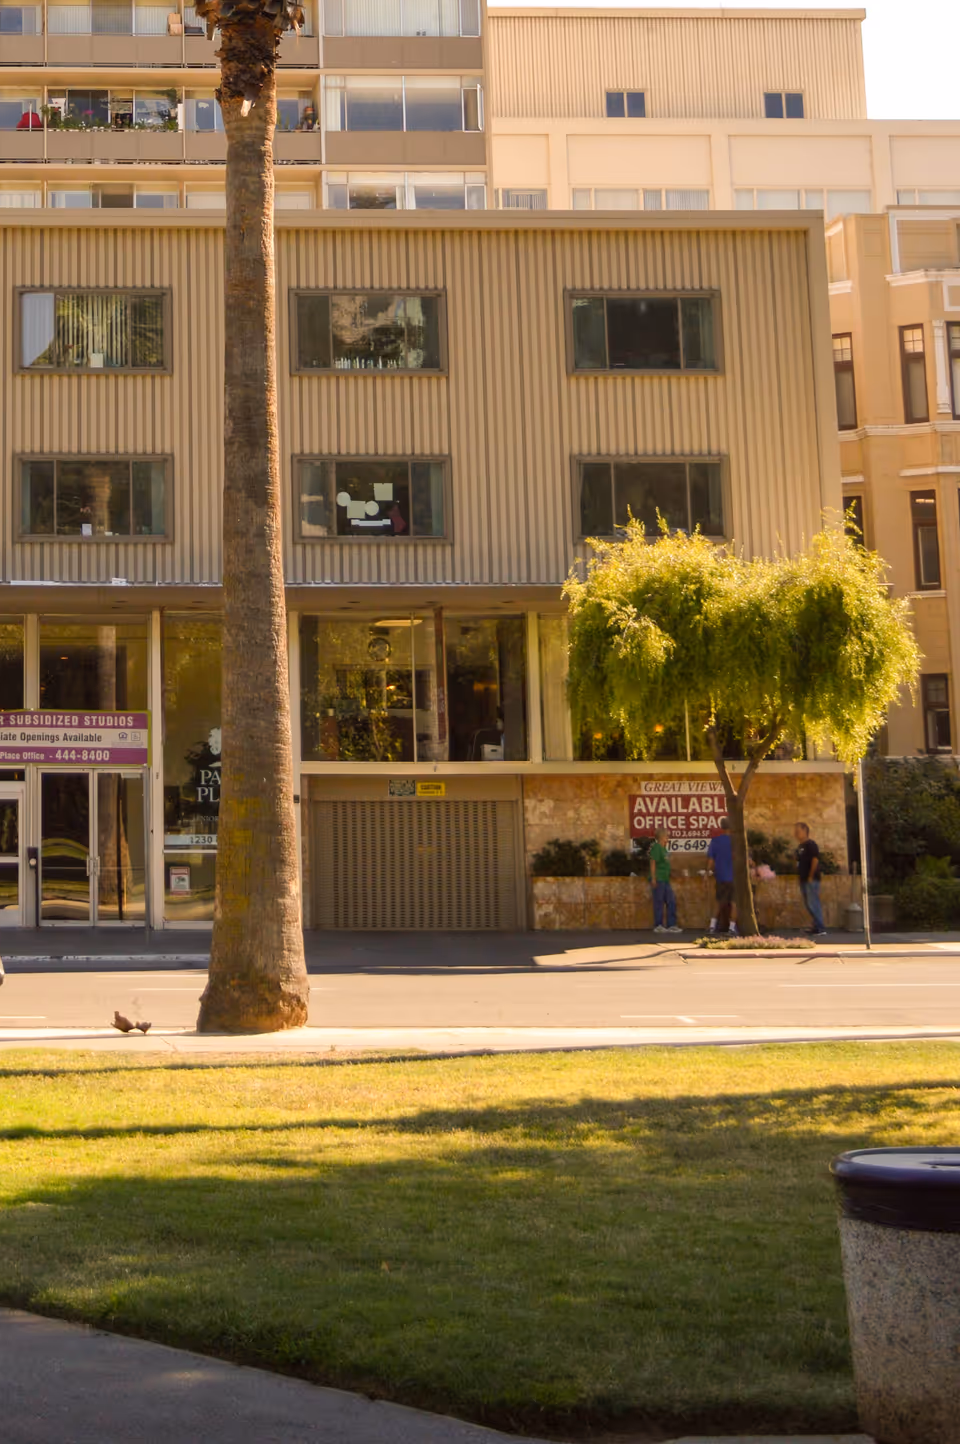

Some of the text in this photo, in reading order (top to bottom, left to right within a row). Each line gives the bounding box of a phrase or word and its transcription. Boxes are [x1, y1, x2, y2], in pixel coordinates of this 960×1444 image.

[9, 714, 79, 726] SUBSIDIZED
[84, 716, 134, 727] STUDIOS
[20, 732, 60, 744] Openings
[62, 733, 103, 743] Available
[0, 752, 20, 760] Place
[23, 752, 45, 761] Office
[55, 749, 111, 761] 444-8400
[200, 769, 221, 785] PA
[644, 782, 683, 793] GREAT
[633, 816, 728, 829] OFFICE SPAC
